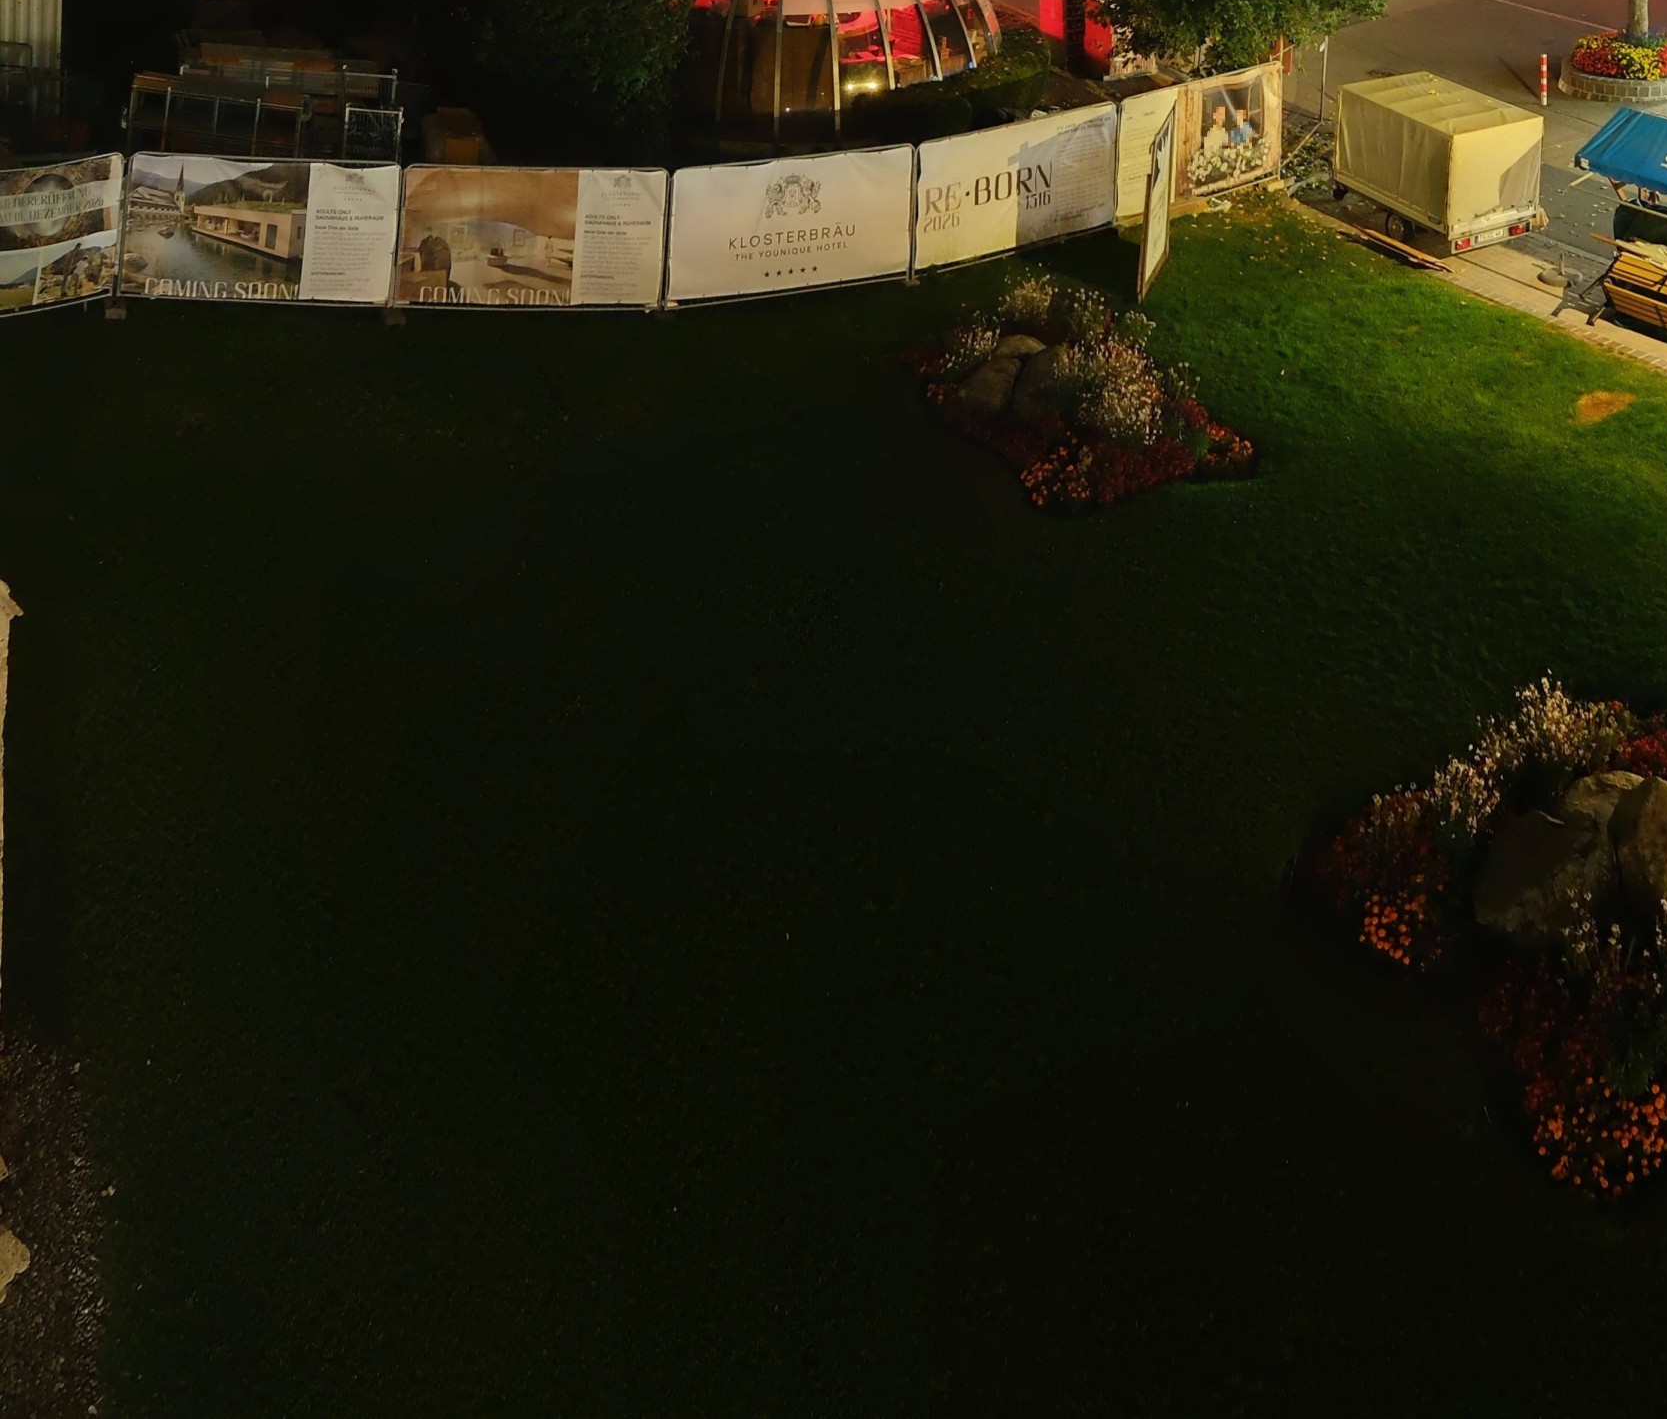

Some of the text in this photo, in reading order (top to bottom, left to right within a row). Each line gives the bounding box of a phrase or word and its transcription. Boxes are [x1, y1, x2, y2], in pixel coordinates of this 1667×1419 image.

[1025, 191, 1050, 211] 1516
[924, 212, 960, 233] 2026
[728, 222, 856, 251] KLOSTERBRÄU
[735, 241, 847, 261] THE YOUNIQUE HOTEL
